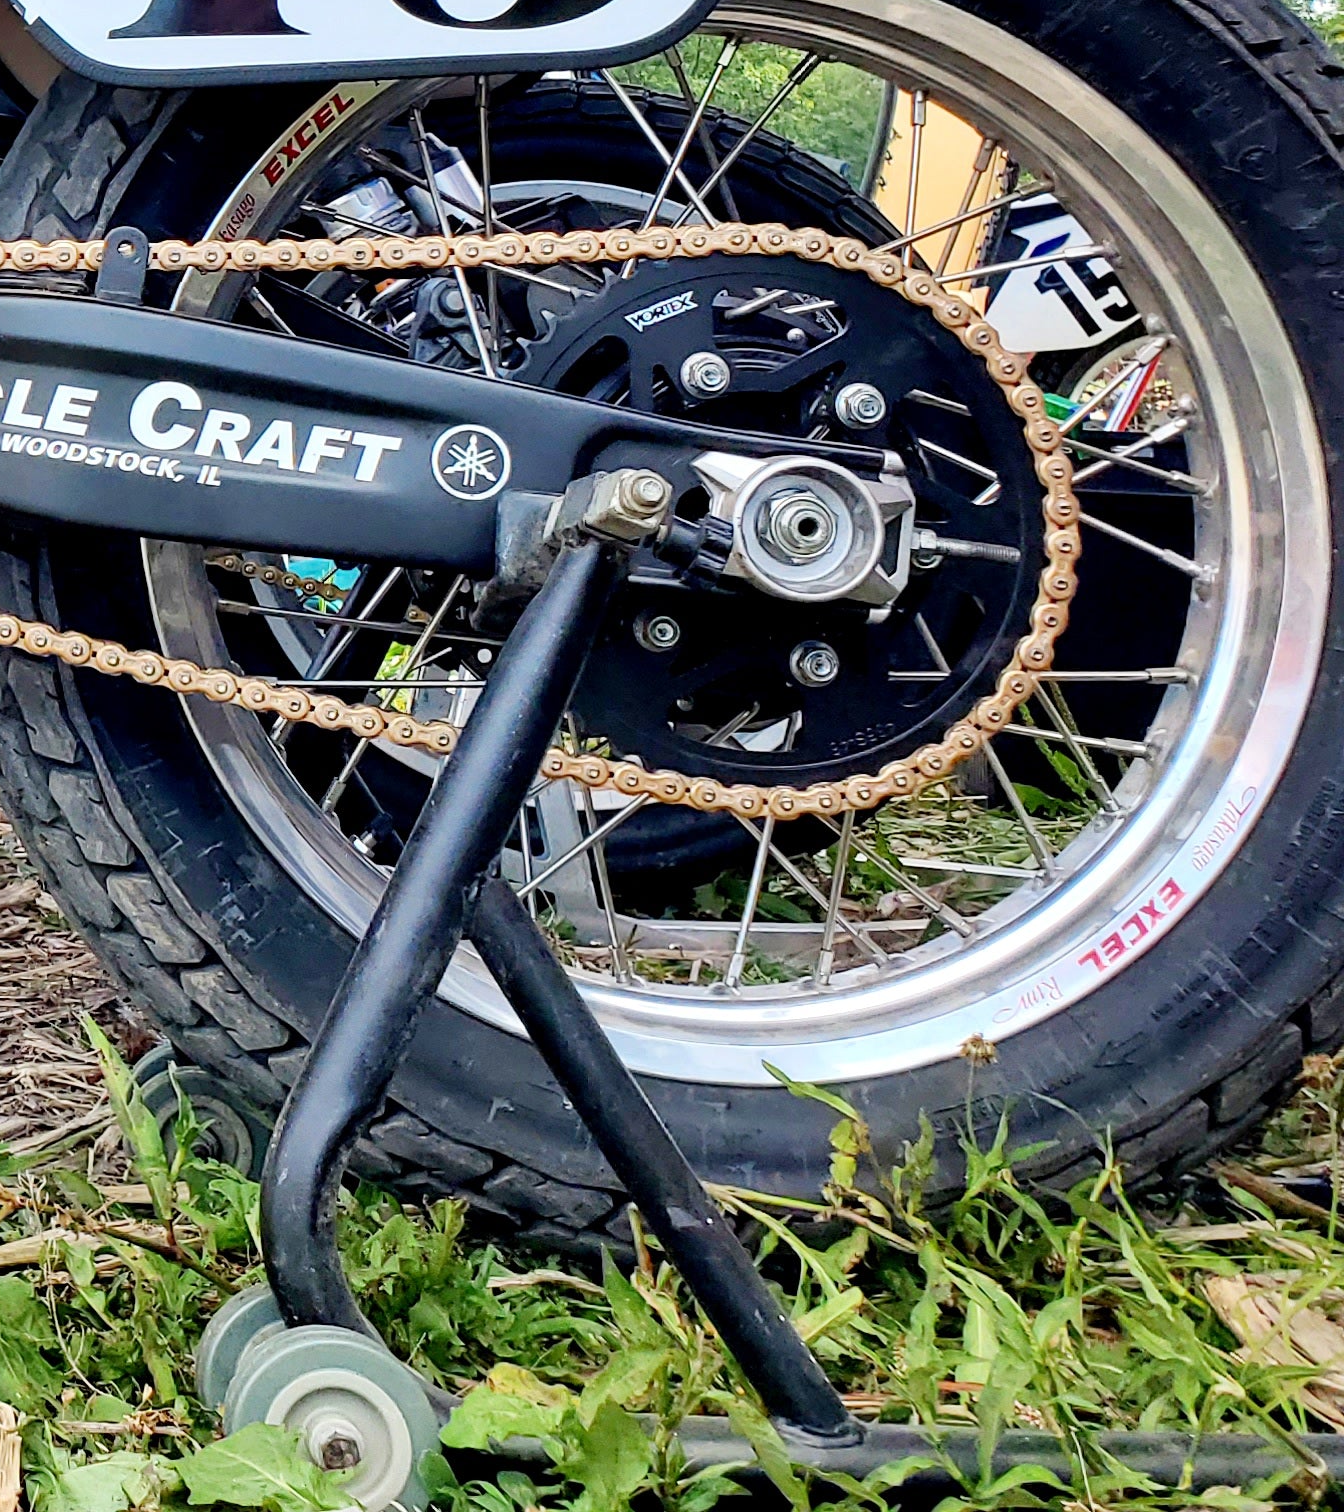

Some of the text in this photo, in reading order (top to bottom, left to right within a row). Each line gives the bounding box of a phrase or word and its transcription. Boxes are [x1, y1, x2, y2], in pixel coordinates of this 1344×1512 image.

[261, 92, 355, 187] EXCEL
[624, 291, 699, 333] VORTEX
[0, 432, 221, 486] WOODSTOCK, IL
[129, 380, 402, 482] CRAFT
[1077, 877, 1188, 975] EXCEL
